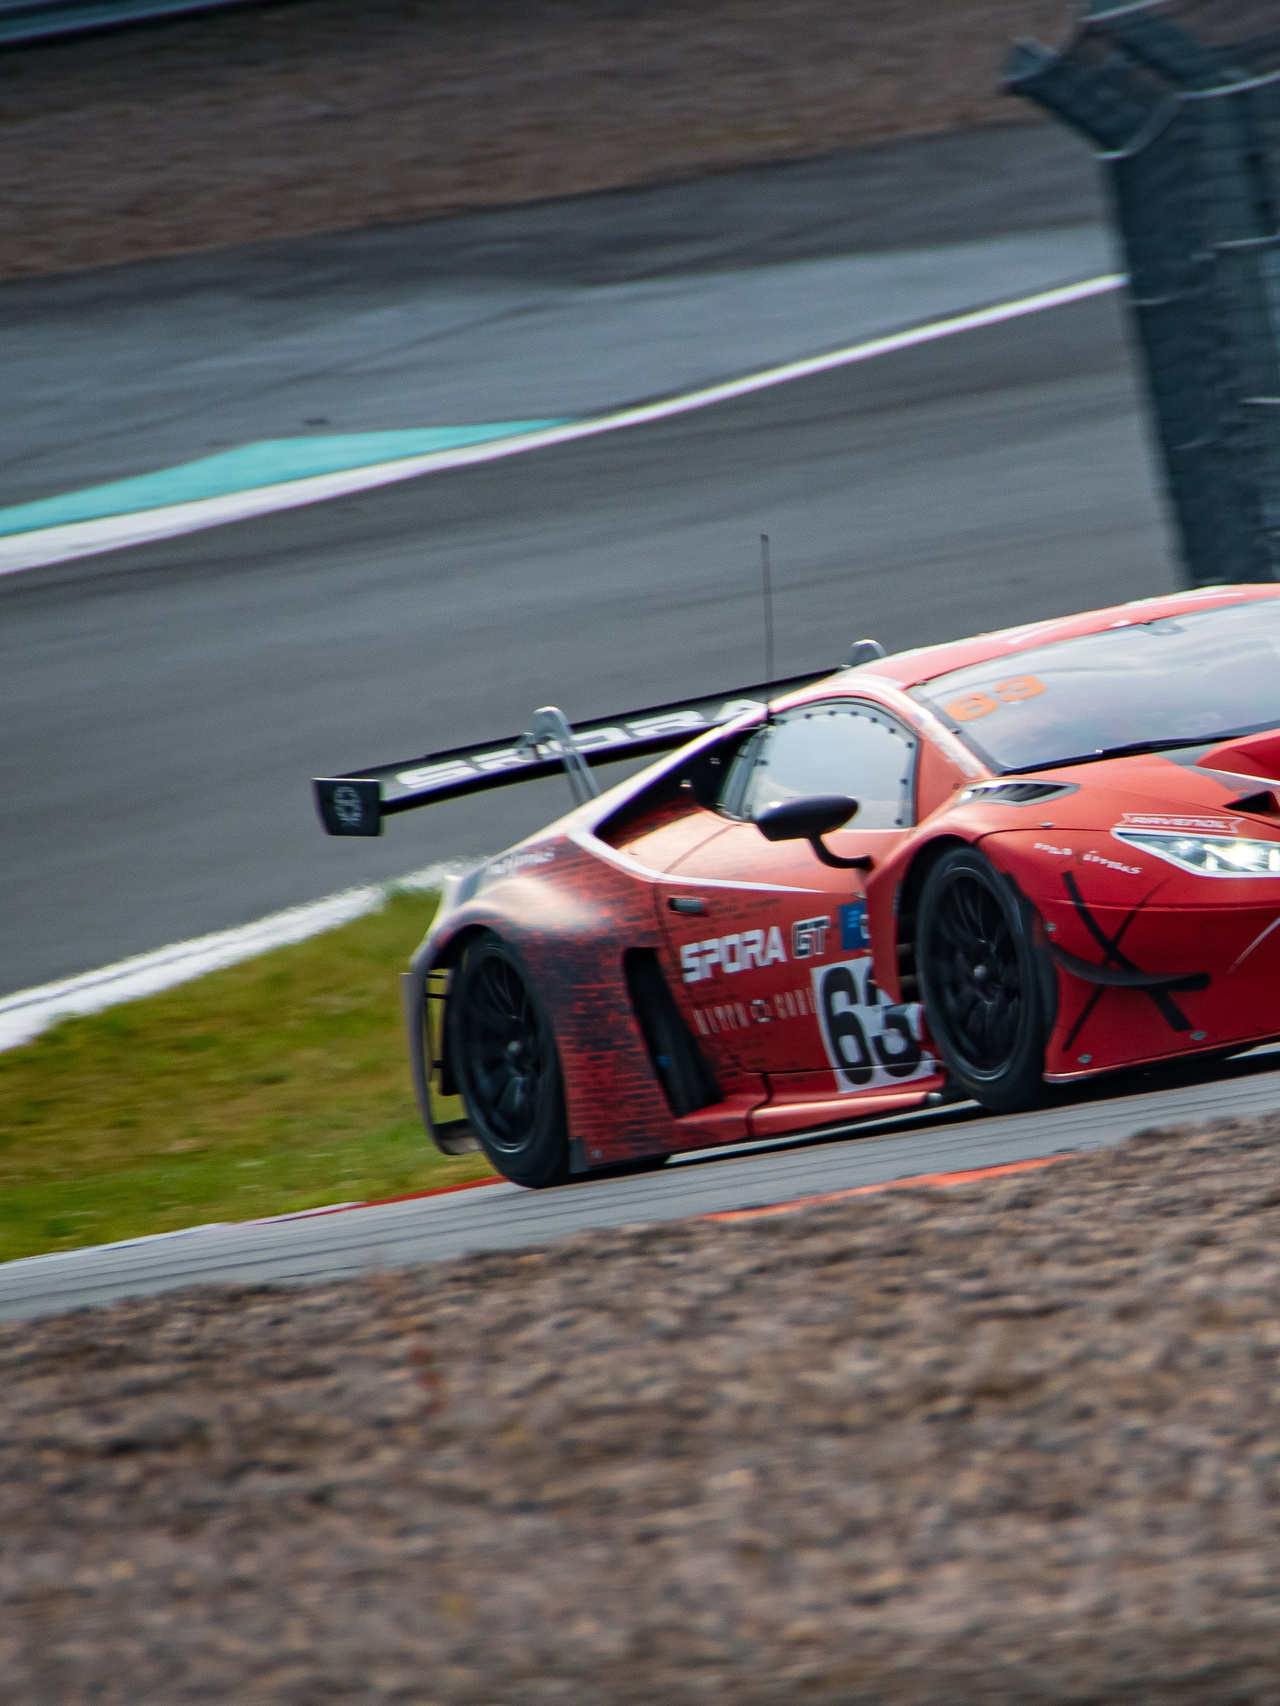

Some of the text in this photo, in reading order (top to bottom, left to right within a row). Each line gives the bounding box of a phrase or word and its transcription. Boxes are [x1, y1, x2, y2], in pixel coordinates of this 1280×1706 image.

[945, 675, 1046, 722] 63
[680, 926, 788, 983] SPORA
[791, 915, 832, 960] GT
[821, 966, 923, 1086] 63
